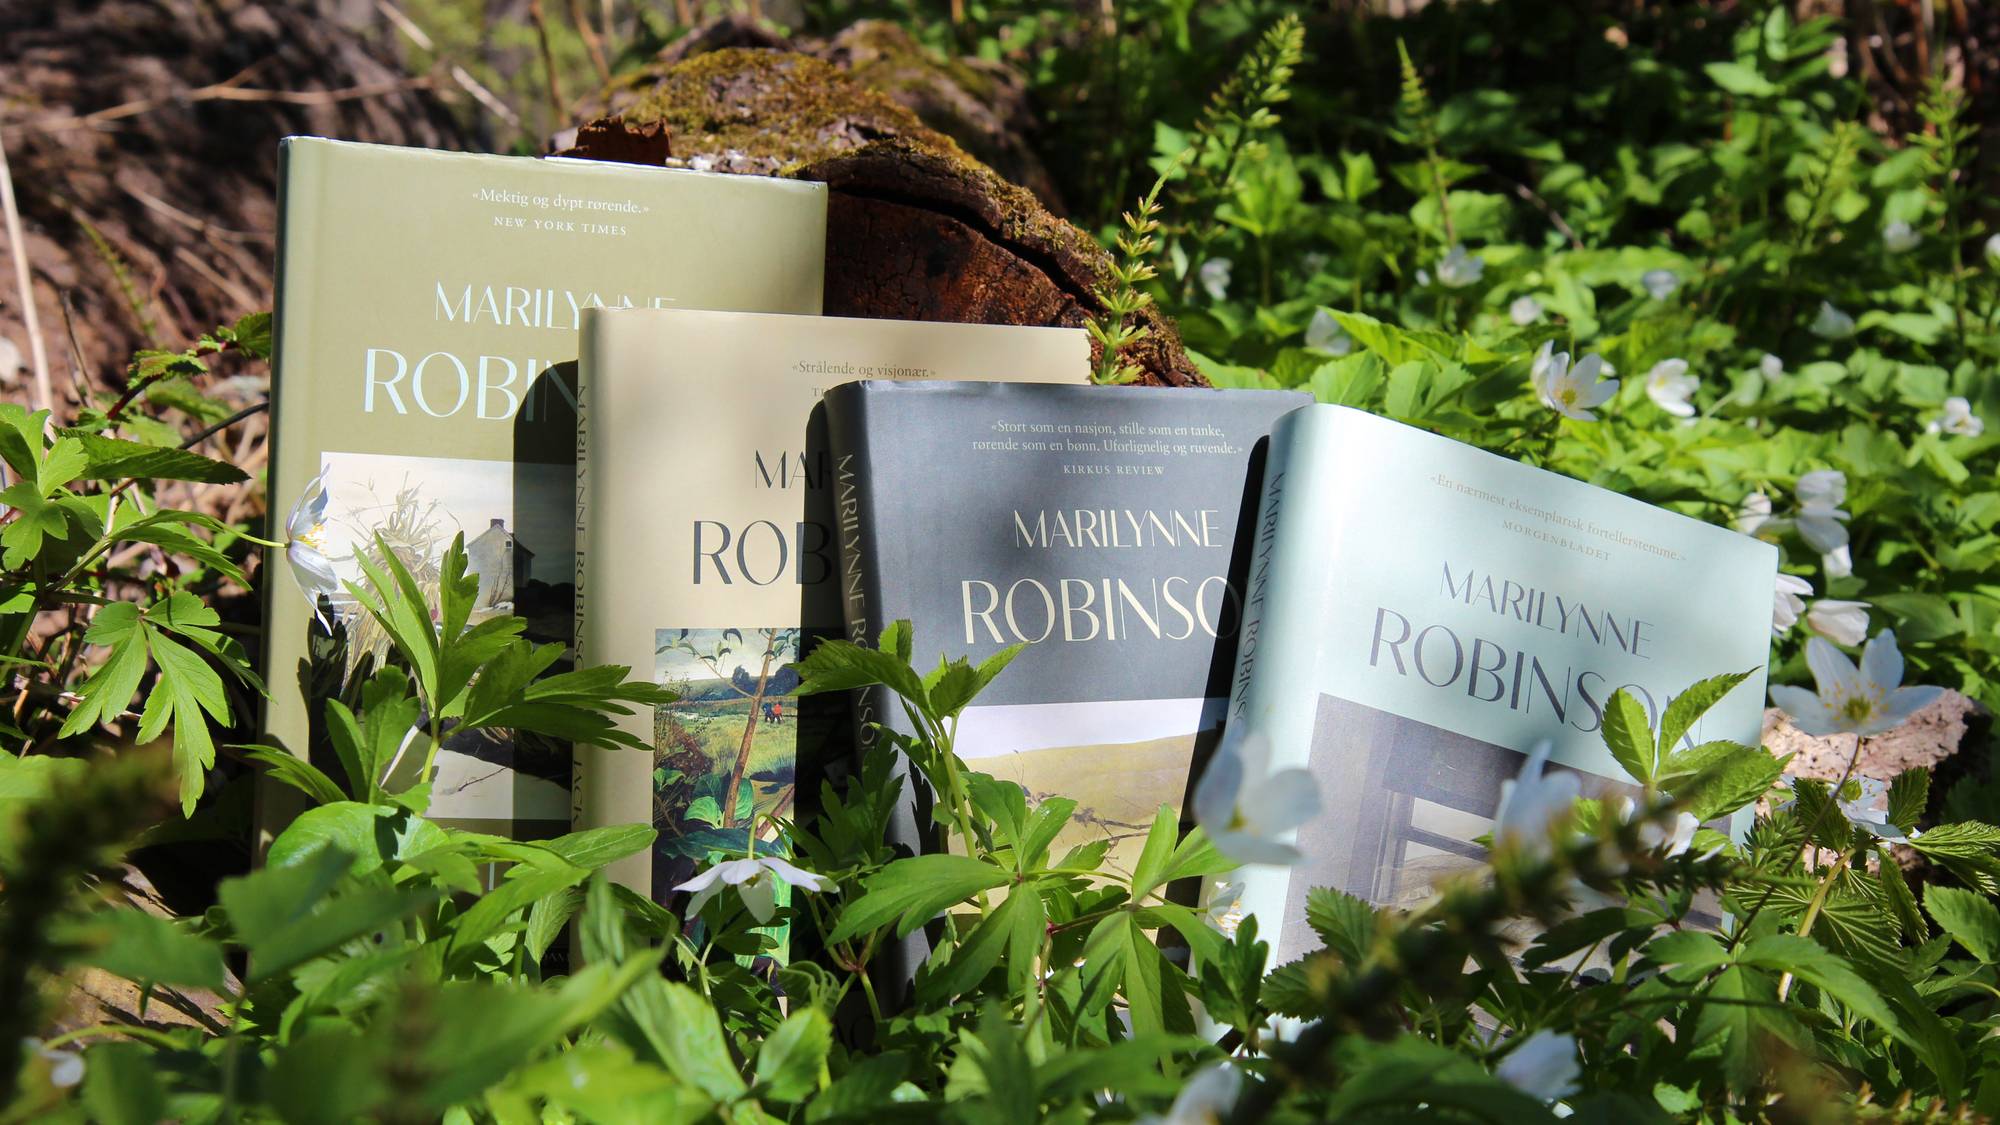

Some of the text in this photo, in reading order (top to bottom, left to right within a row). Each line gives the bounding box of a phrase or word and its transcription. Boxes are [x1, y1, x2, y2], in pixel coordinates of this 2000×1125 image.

[472, 188, 649, 214] «Mektig og dypt rørende.»
[494, 216, 627, 236] NEW YORK TIMES
[792, 360, 855, 375] «Strålende
[858, 366, 874, 378] og
[991, 419, 1225, 438] «Stort som en nasjon, stille som en tanke,
[972, 437, 1018, 450] rørende
[1022, 440, 1046, 451] som
[1049, 441, 1063, 451] en
[1067, 438, 1100, 452] bønn.
[1104, 439, 1170, 456] Uforlignelig
[1172, 444, 1188, 456] og
[1063, 464, 1165, 476] KIRKUS REVIEW
[1456, 482, 1506, 506] nærmest
[1508, 498, 1584, 532] eksemplarisk
[1014, 509, 1223, 548] MARILYNNE
[1251, 471, 1286, 611] MARILYNNE
[1501, 519, 1612, 561] MORGENBLADET
[837, 454, 875, 751] MARILYNNE RONSO
[1440, 560, 1655, 660] MARILYNNE
